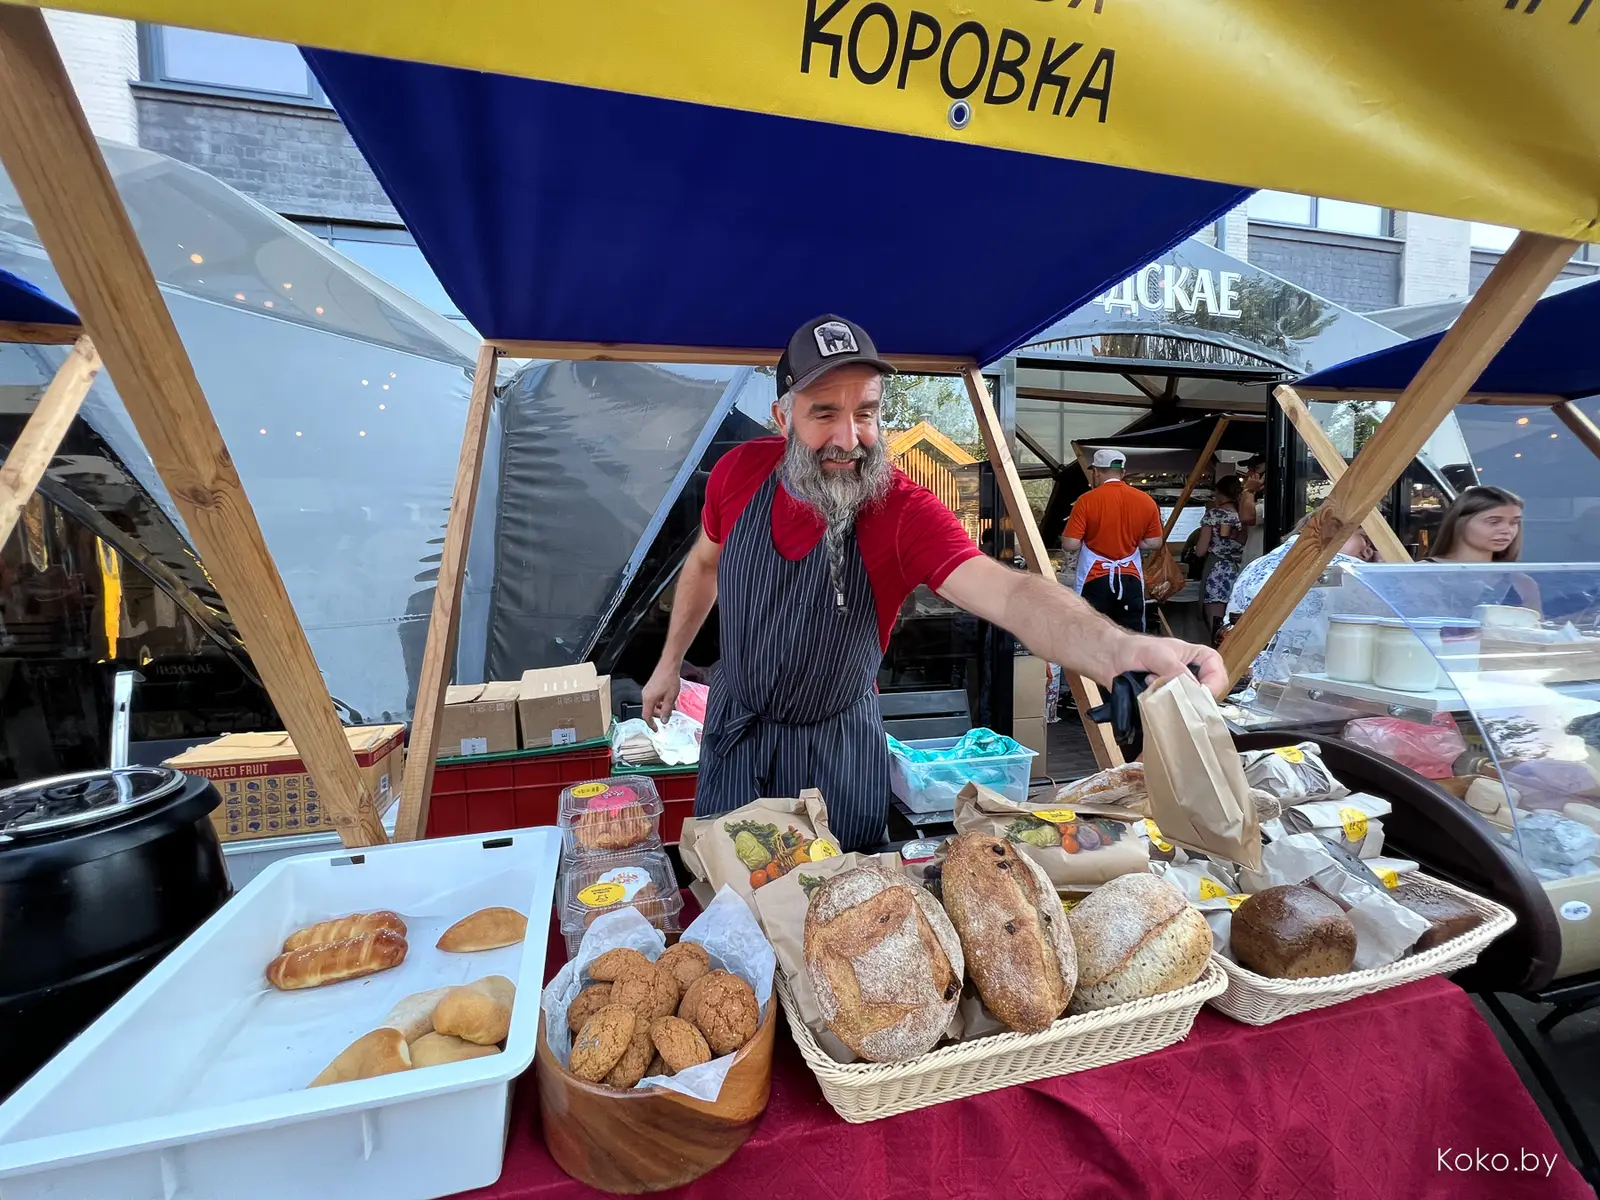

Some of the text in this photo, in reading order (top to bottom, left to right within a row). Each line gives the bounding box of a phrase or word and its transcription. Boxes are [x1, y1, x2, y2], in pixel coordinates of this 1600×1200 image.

[800, 0, 1115, 123] КОРОВКА
[183, 763, 269, 779] DRATED FRUIT
